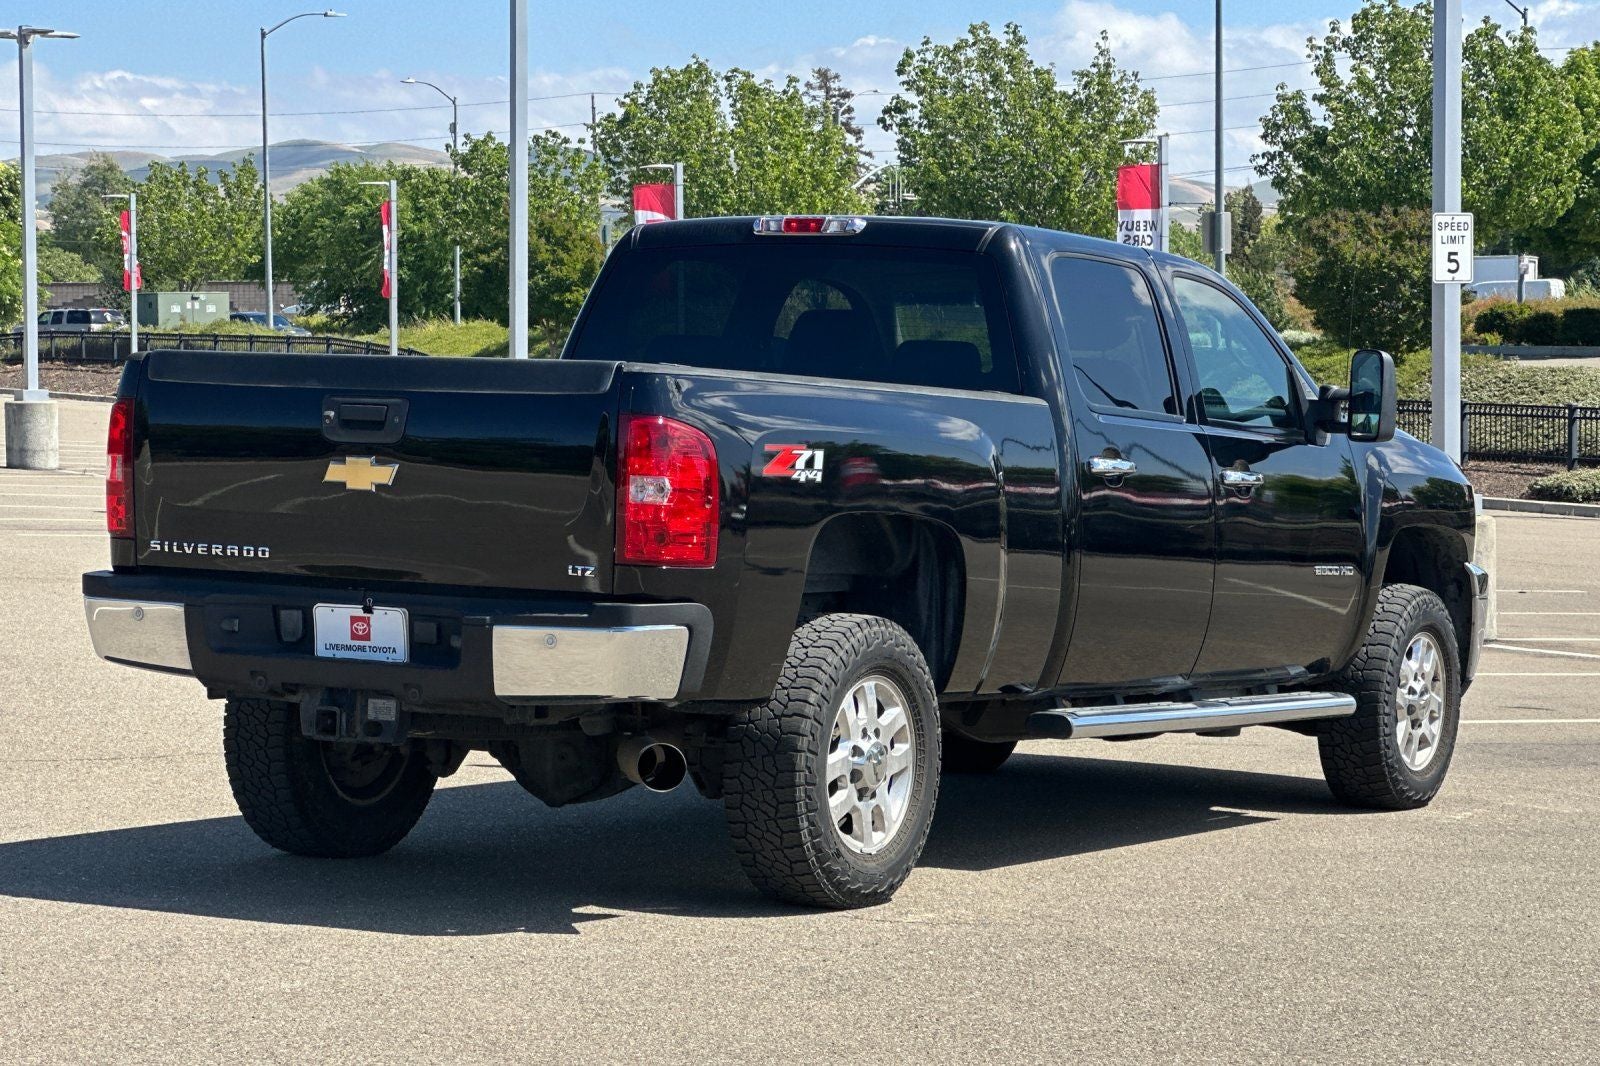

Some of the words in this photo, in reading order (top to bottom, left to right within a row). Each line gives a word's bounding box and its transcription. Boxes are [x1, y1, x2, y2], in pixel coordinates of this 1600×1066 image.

[1437, 221, 1470, 232] SPEED
[1440, 235, 1466, 245] LIMIT
[1447, 251, 1460, 274] 5
[762, 444, 824, 477] Z71
[150, 540, 270, 558] SILVERADO
[568, 564, 596, 577] LTZ
[324, 643, 367, 653] LIVERMORE
[368, 645, 397, 655] TOYOTA
